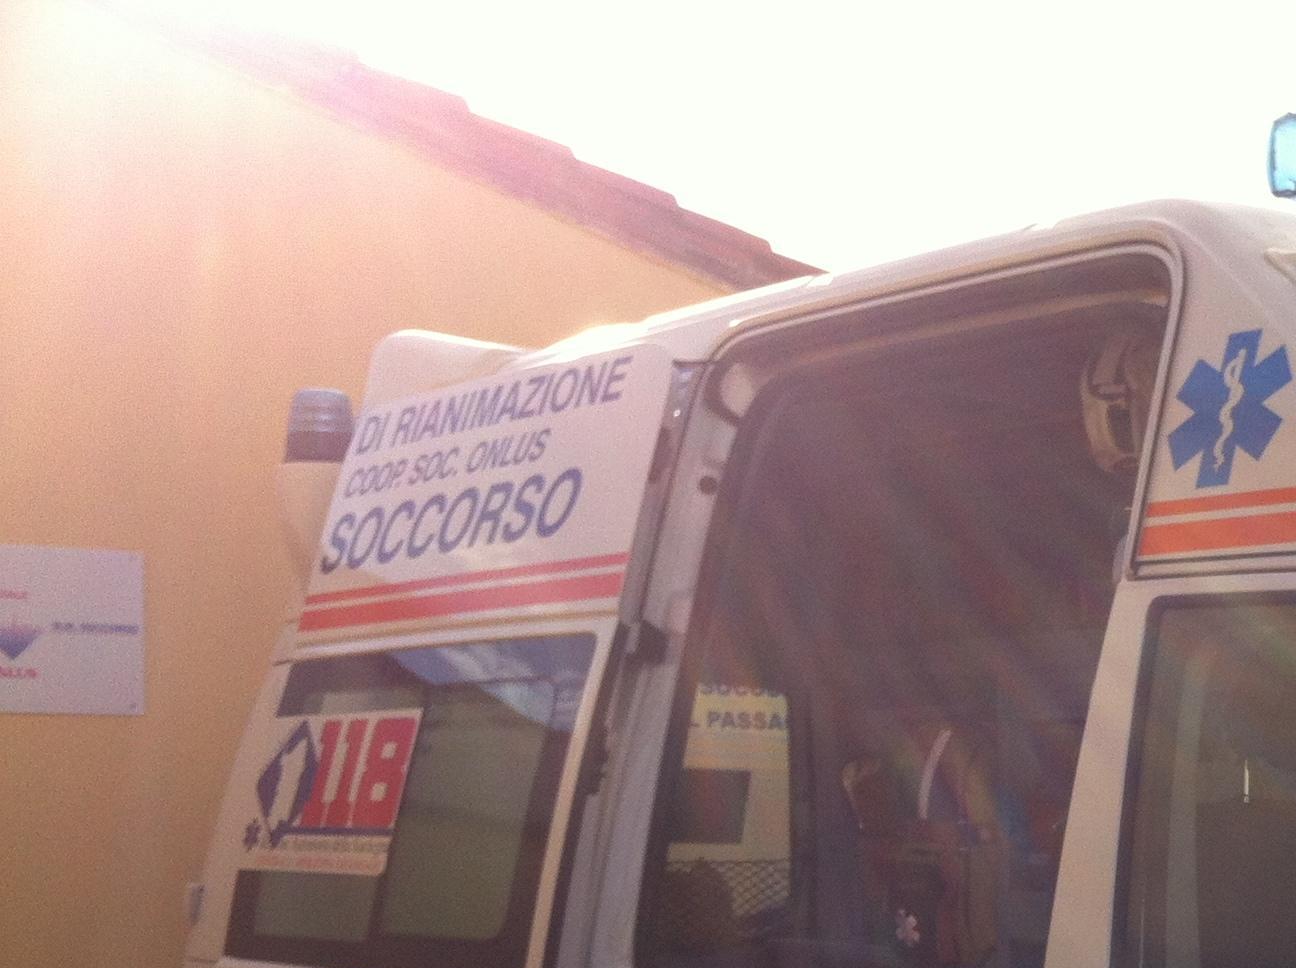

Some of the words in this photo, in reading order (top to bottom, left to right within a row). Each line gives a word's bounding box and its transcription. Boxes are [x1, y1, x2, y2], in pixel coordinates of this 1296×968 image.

[356, 412, 392, 455] DI
[391, 355, 633, 448] RIANIMAZIONE
[466, 428, 552, 474] ONLUS
[320, 468, 584, 574] SOCCORSO
